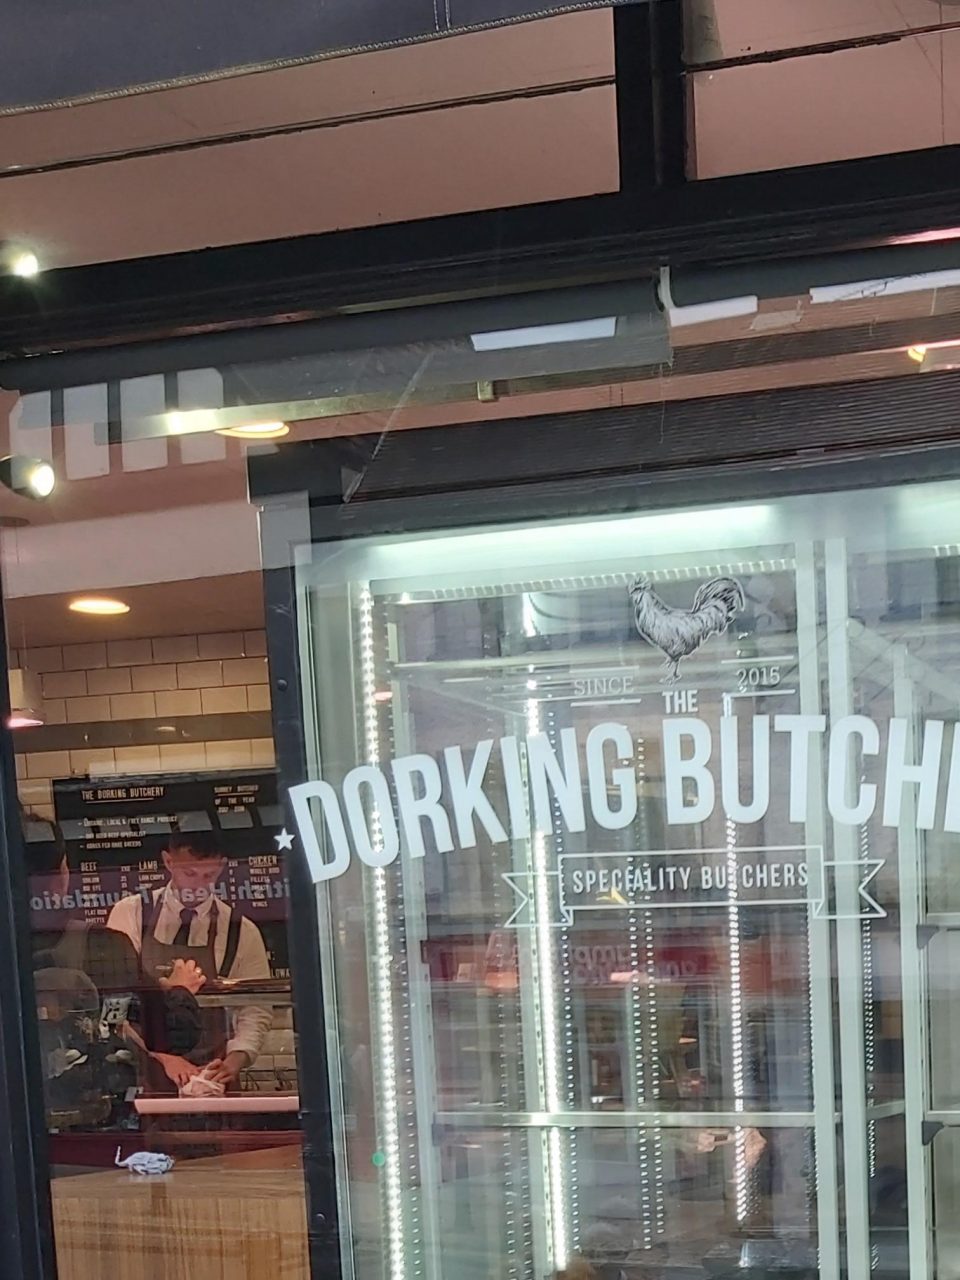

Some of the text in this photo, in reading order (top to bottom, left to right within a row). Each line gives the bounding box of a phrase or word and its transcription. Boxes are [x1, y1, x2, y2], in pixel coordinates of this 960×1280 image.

[573, 666, 782, 697] SINCE 2015
[662, 689, 699, 714] THE
[82, 786, 165, 800] THE DORKING BUTCHERY
[288, 720, 638, 884] DORKING
[81, 861, 98, 872] BEEF
[138, 860, 158, 871] LAMB
[248, 855, 277, 866] CHICKEN
[572, 866, 691, 894] SPECIALITY
